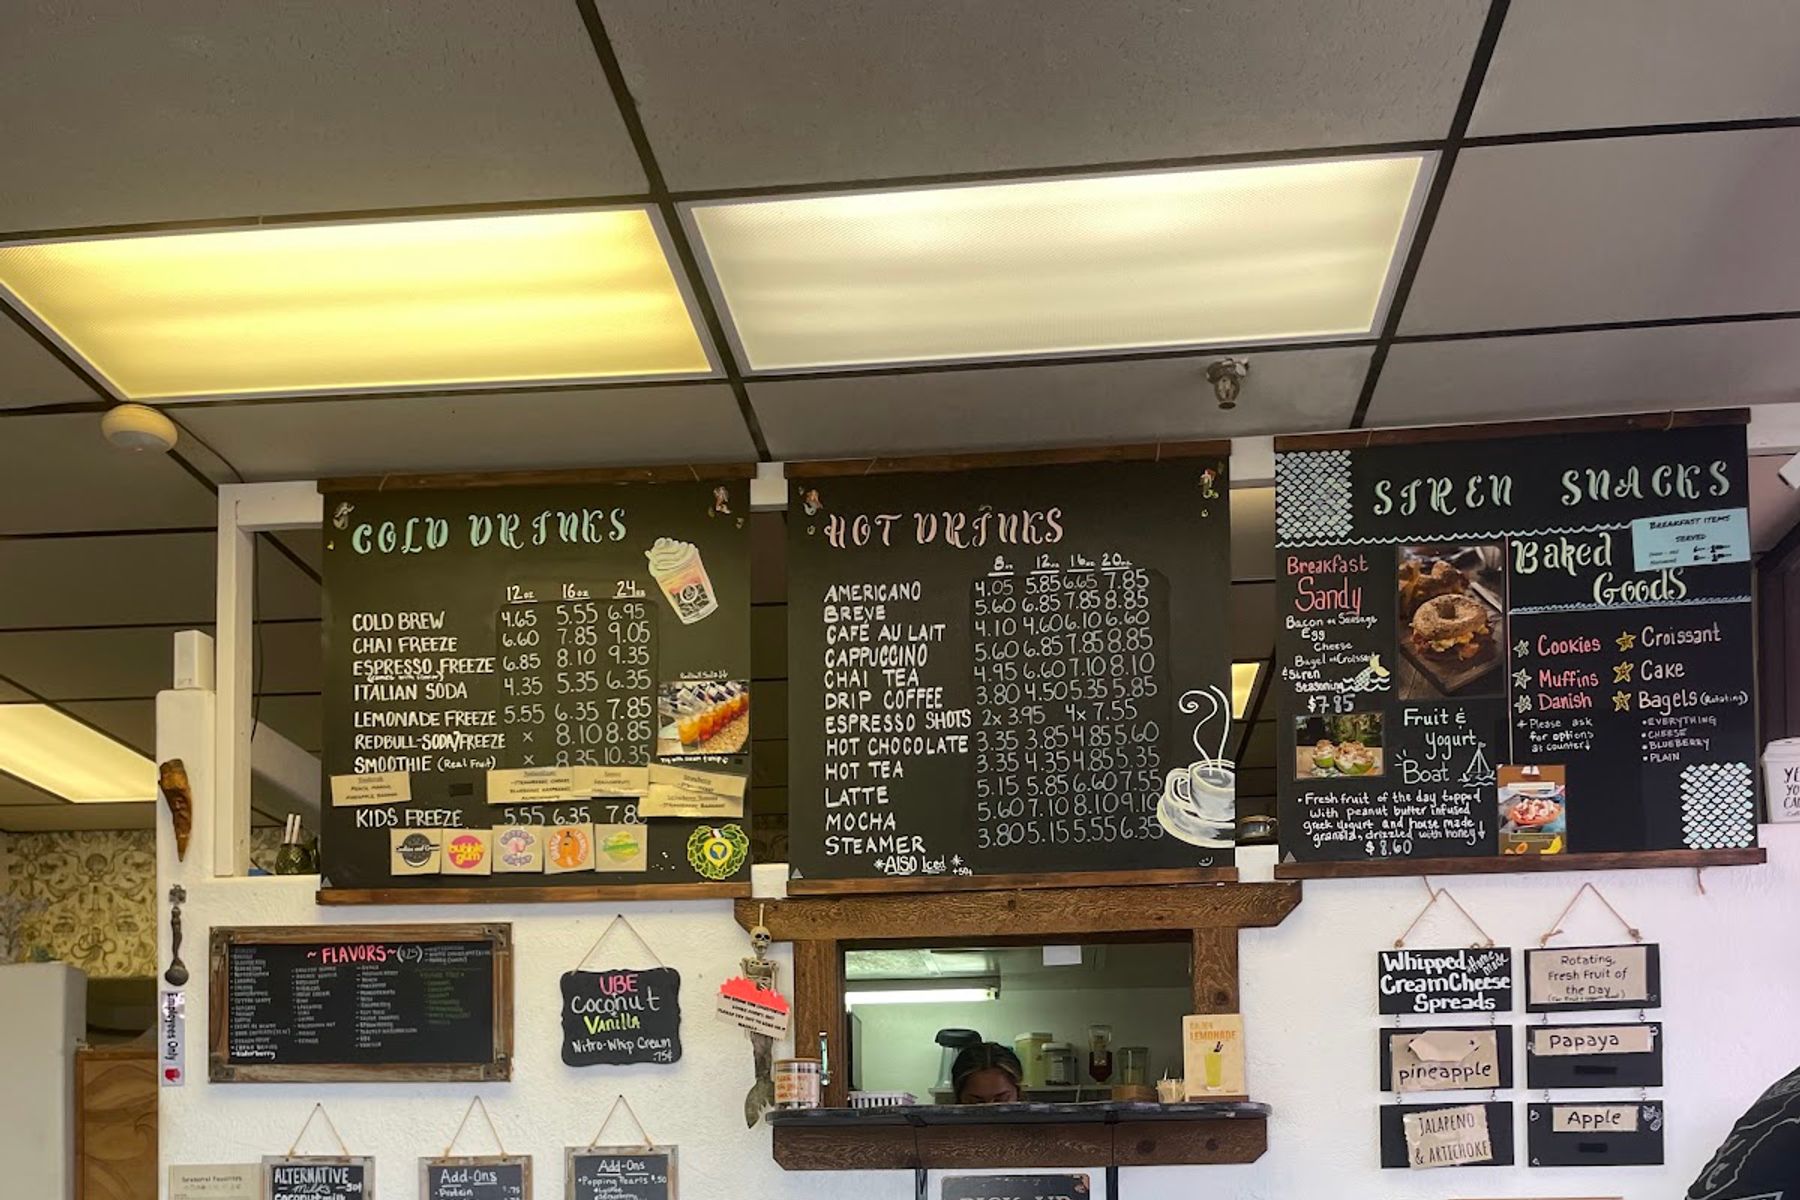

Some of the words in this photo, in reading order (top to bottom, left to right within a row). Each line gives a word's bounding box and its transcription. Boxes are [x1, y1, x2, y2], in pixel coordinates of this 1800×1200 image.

[1373, 474, 1513, 516] SIREN
[1561, 459, 1731, 507] SNACKS
[352, 517, 449, 554] COLD
[469, 508, 627, 549] DRINKS
[824, 513, 902, 548] HOT
[914, 505, 1064, 548] DRINKS
[1650, 518, 1701, 529] BREAKFAST
[1704, 515, 1730, 524] ITEMS
[1675, 534, 1707, 542] SERVED
[1511, 532, 1613, 575] Baked
[1287, 554, 1368, 575] Breakfast
[824, 581, 921, 602] AMERICANO
[975, 579, 1014, 597] 4.05
[1026, 575, 1061, 594] 5.85
[1063, 574, 1098, 589] 6.65
[1103, 569, 1149, 589] 7.85
[1295, 576, 1362, 616] Sandy
[352, 613, 394, 632] COLD
[398, 611, 445, 631] BREW
[502, 610, 537, 627] 4.65
[557, 603, 598, 625] 5.55
[608, 603, 645, 620] 6.95
[824, 605, 886, 623] BREVE
[1286, 615, 1323, 629] Bacon
[826, 619, 869, 645] CAFÉ
[878, 624, 901, 642] AU
[908, 624, 946, 642] LAIT
[1301, 629, 1325, 641] Egg
[1537, 635, 1600, 656] Cookies
[1641, 622, 1722, 648] Croissant
[353, 637, 392, 654] CHAI
[399, 637, 458, 653] FREEZE
[1314, 643, 1353, 652] Cheese
[353, 658, 432, 676] ESPRESSO
[440, 656, 496, 673] FREEZE
[503, 653, 541, 671] 6.85
[557, 648, 596, 668] 8.10
[608, 645, 650, 665] 9.35
[824, 643, 927, 669] CAPPUCCINO
[1295, 654, 1326, 669] Bagel
[824, 669, 868, 689] CHAI
[882, 668, 920, 687] TEA
[1538, 669, 1599, 688] Muffins
[1640, 660, 1685, 681] Cake
[354, 683, 417, 701] ITALIAN
[426, 681, 468, 700] SODA
[825, 690, 872, 710] DRIP
[883, 687, 943, 709] COFFEE
[1538, 692, 1592, 711] Danish
[1638, 689, 1698, 716] Bagels
[354, 711, 440, 728] LEMONADE
[444, 710, 497, 726] FREEZE
[826, 713, 916, 735] ESPRESSO
[925, 708, 972, 730] SHOTS
[1008, 705, 1046, 725] 3.95
[1093, 698, 1137, 721] 7.55
[1404, 708, 1449, 726] Fruit
[1530, 718, 1561, 729] Please
[1572, 717, 1593, 727] ask
[1647, 715, 1718, 727] EVERYTHING
[1530, 731, 1549, 742] for
[1553, 731, 1594, 742] options
[1648, 728, 1687, 738] CHEESE
[826, 737, 860, 757] HOT
[868, 735, 969, 756] CHOCOLATE
[1547, 742, 1584, 751] counter
[1649, 738, 1710, 751] BLUEBERRY
[354, 755, 432, 774] SMOOTHIE
[438, 757, 467, 772] (Real
[1650, 752, 1681, 763] PLAIN
[825, 762, 860, 781] HOT
[868, 760, 904, 779] TEA
[1403, 759, 1450, 784] Boat
[825, 786, 889, 808] LATTE
[1305, 792, 1338, 804] Fresh
[1377, 792, 1390, 803] of
[1392, 792, 1412, 802] the
[1416, 789, 1436, 807] day
[356, 808, 398, 827] KIDS
[406, 809, 463, 827] FREEZE
[825, 812, 896, 831] MOCHA
[1346, 806, 1388, 821] peanut
[1394, 805, 1427, 816] butter
[1431, 804, 1470, 816] infused
[1382, 819, 1404, 830] and
[1443, 816, 1475, 828] made
[825, 835, 926, 856] STEAMER
[1365, 828, 1413, 839] drizzled
[1445, 826, 1476, 845] honey
[322, 945, 387, 964] FLAVORS
[1382, 950, 1467, 975] Whipped
[1380, 973, 1449, 995] Cream
[1449, 972, 1511, 992] Cheese
[1548, 970, 1580, 980] Fresh
[1584, 969, 1611, 980] Fruit
[1615, 967, 1628, 979] of
[599, 973, 638, 996] UBE
[1566, 985, 1585, 995] the
[1588, 985, 1611, 997] Day
[571, 986, 661, 1014] Coconut
[1413, 992, 1496, 1013] Spreads
[583, 1014, 641, 1035] Vanilla
[637, 1036, 672, 1049] Cream
[1400, 1062, 1491, 1084] pineapple
[1418, 1113, 1476, 1137] JALAPENO
[1568, 1110, 1622, 1128] Apple
[1429, 1140, 1490, 1164] ARTICHOKE
[274, 1167, 349, 1185] ALTERNATIVE
[582, 1176, 618, 1189] Popping
